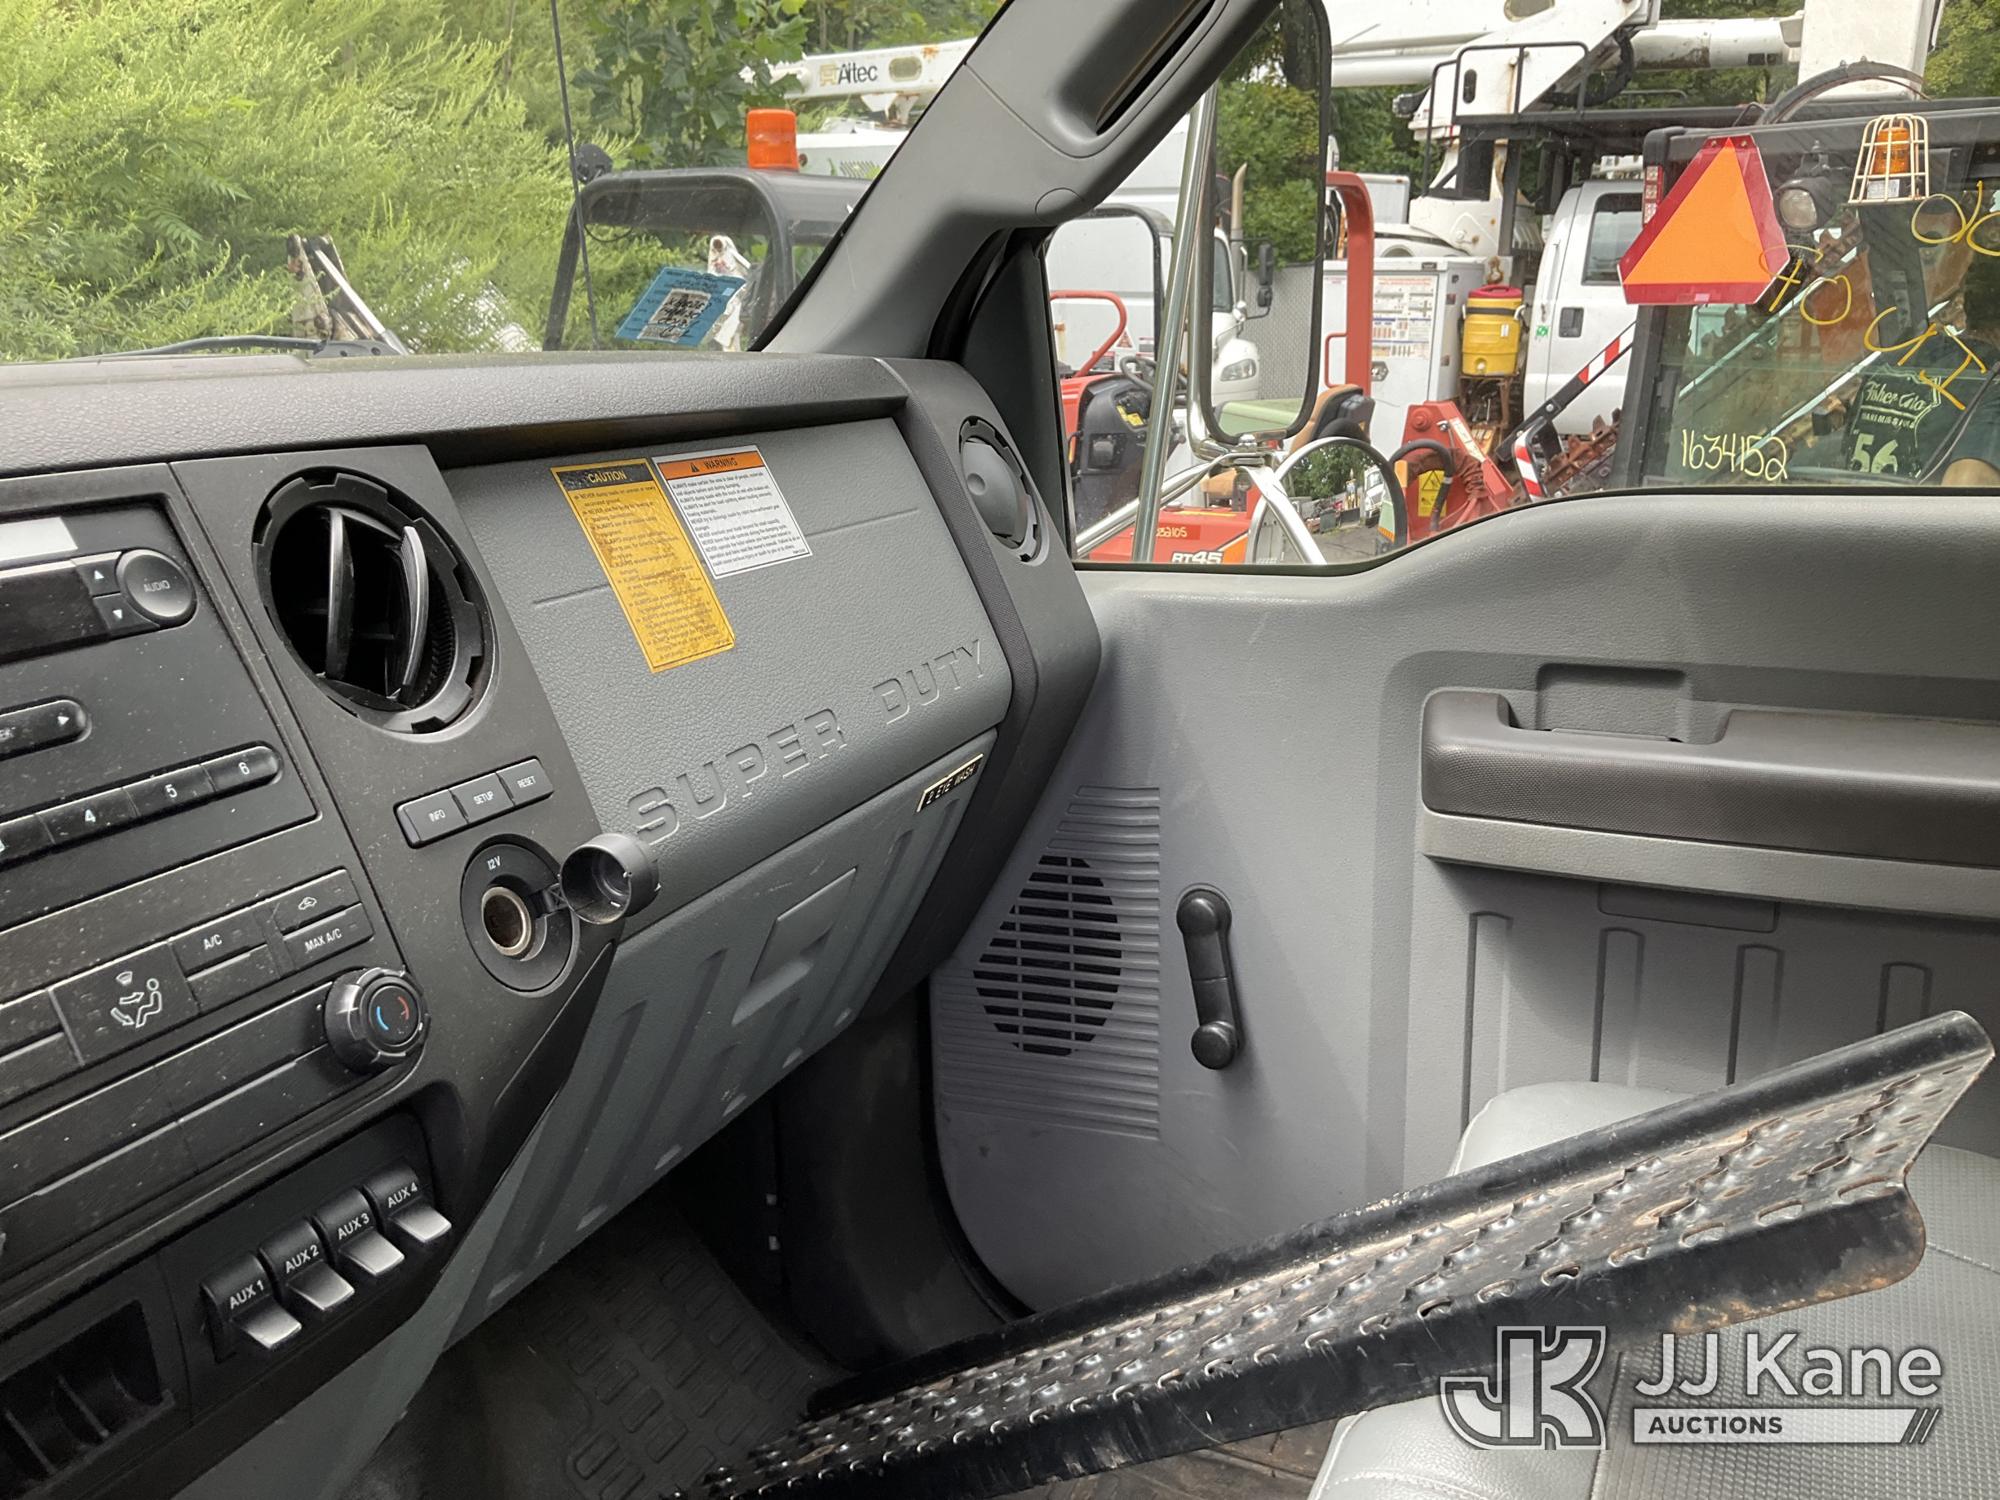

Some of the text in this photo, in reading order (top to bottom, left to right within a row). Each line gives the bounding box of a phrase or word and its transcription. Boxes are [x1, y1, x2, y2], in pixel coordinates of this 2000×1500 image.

[704, 457, 738, 470] WARNING
[1681, 428, 1788, 482] 1634152
[587, 470, 627, 484] CAUTION
[143, 580, 171, 593] AUDIO
[627, 639, 984, 846] SUPER DUTY
[84, 762, 251, 823] 4 5 6
[517, 775, 537, 790] RESET
[473, 791, 495, 805] SETUP
[428, 808, 446, 822] INFO
[203, 934, 223, 950] A/C
[304, 928, 343, 952] MAX A/C
[387, 1182, 418, 1209] AUX 4
[337, 1213, 370, 1240] AUX 3
[284, 1244, 320, 1274] AUX 2
[229, 1279, 265, 1310] AUX 1
